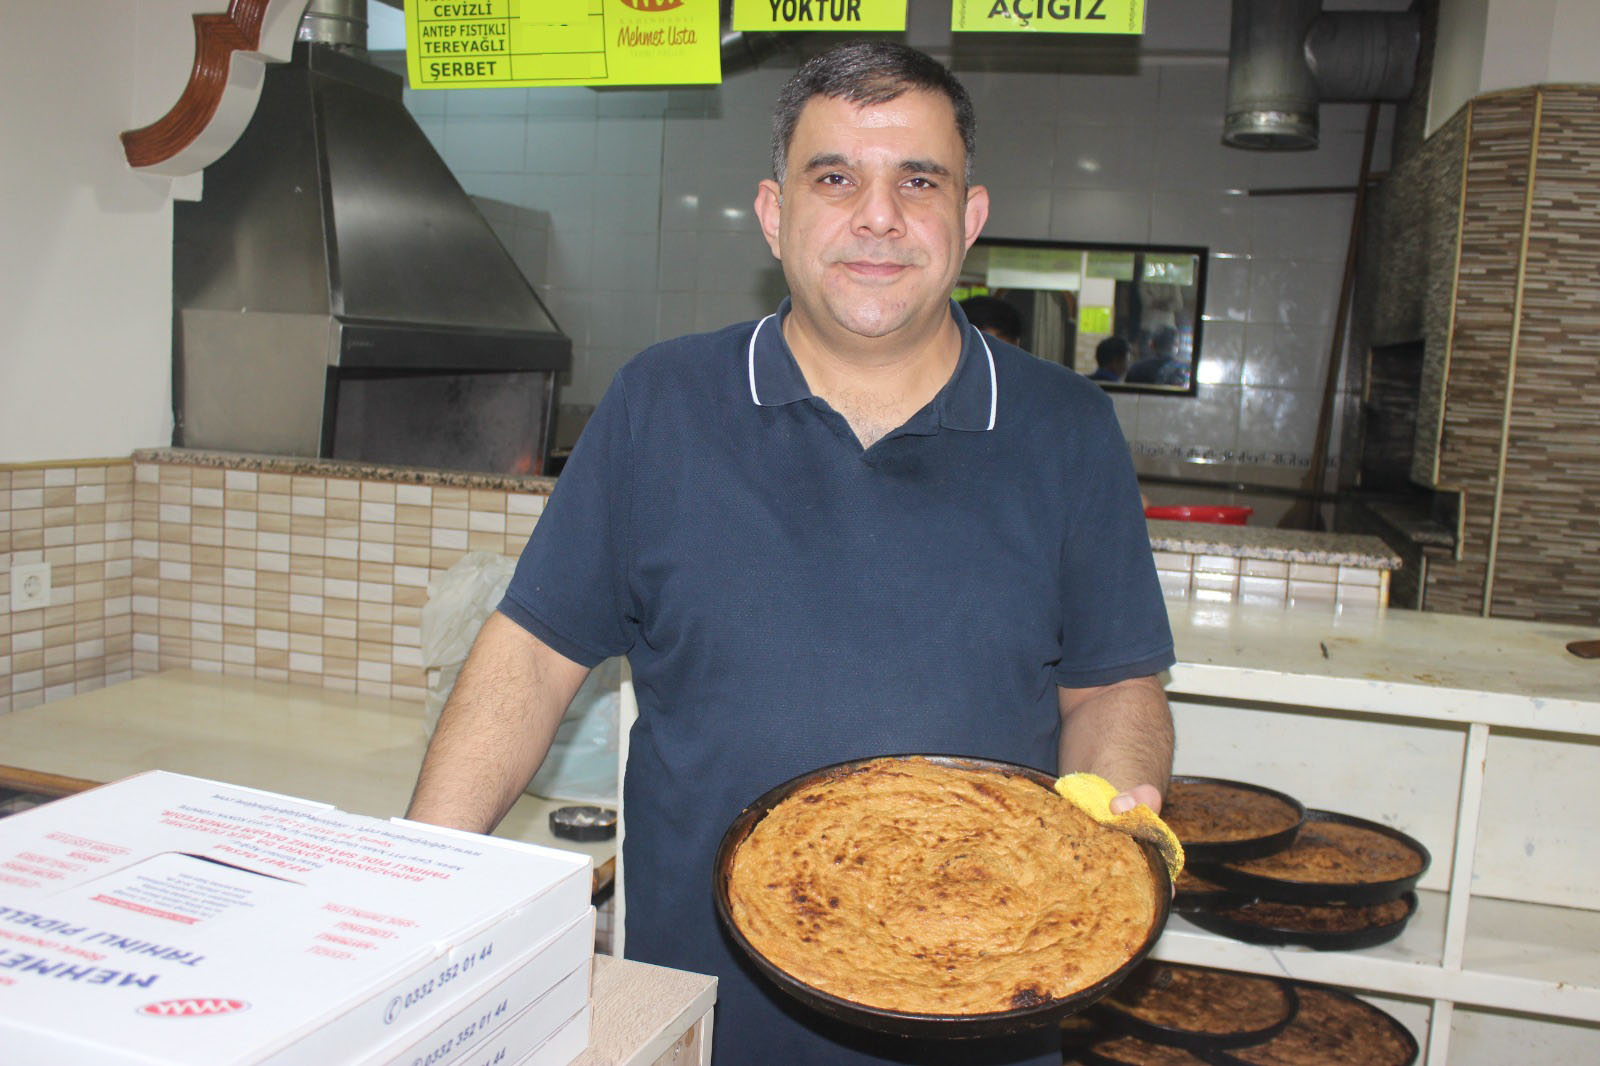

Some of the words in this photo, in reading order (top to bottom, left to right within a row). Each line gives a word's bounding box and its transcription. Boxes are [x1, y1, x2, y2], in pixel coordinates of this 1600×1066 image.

[433, 0, 493, 17] CEVİZLİ
[769, 0, 862, 22] YOKTUR
[423, 25, 457, 38] ANTEP
[460, 23, 506, 36] FISTIKLI
[617, 26, 665, 48] Mehmet
[667, 26, 697, 46] Usta
[424, 36, 505, 53] TEREYAĞLI
[430, 61, 497, 80] ŞERBET
[0, 948, 160, 988] MEHME
[405, 979, 434, 1008] 0332
[437, 963, 460, 987] 352
[463, 952, 477, 972] 01
[480, 941, 494, 960] 44
[456, 1022, 477, 1047] 352
[479, 1011, 492, 1029] 01
[495, 999, 508, 1017] 44
[494, 1046, 506, 1064] 44
